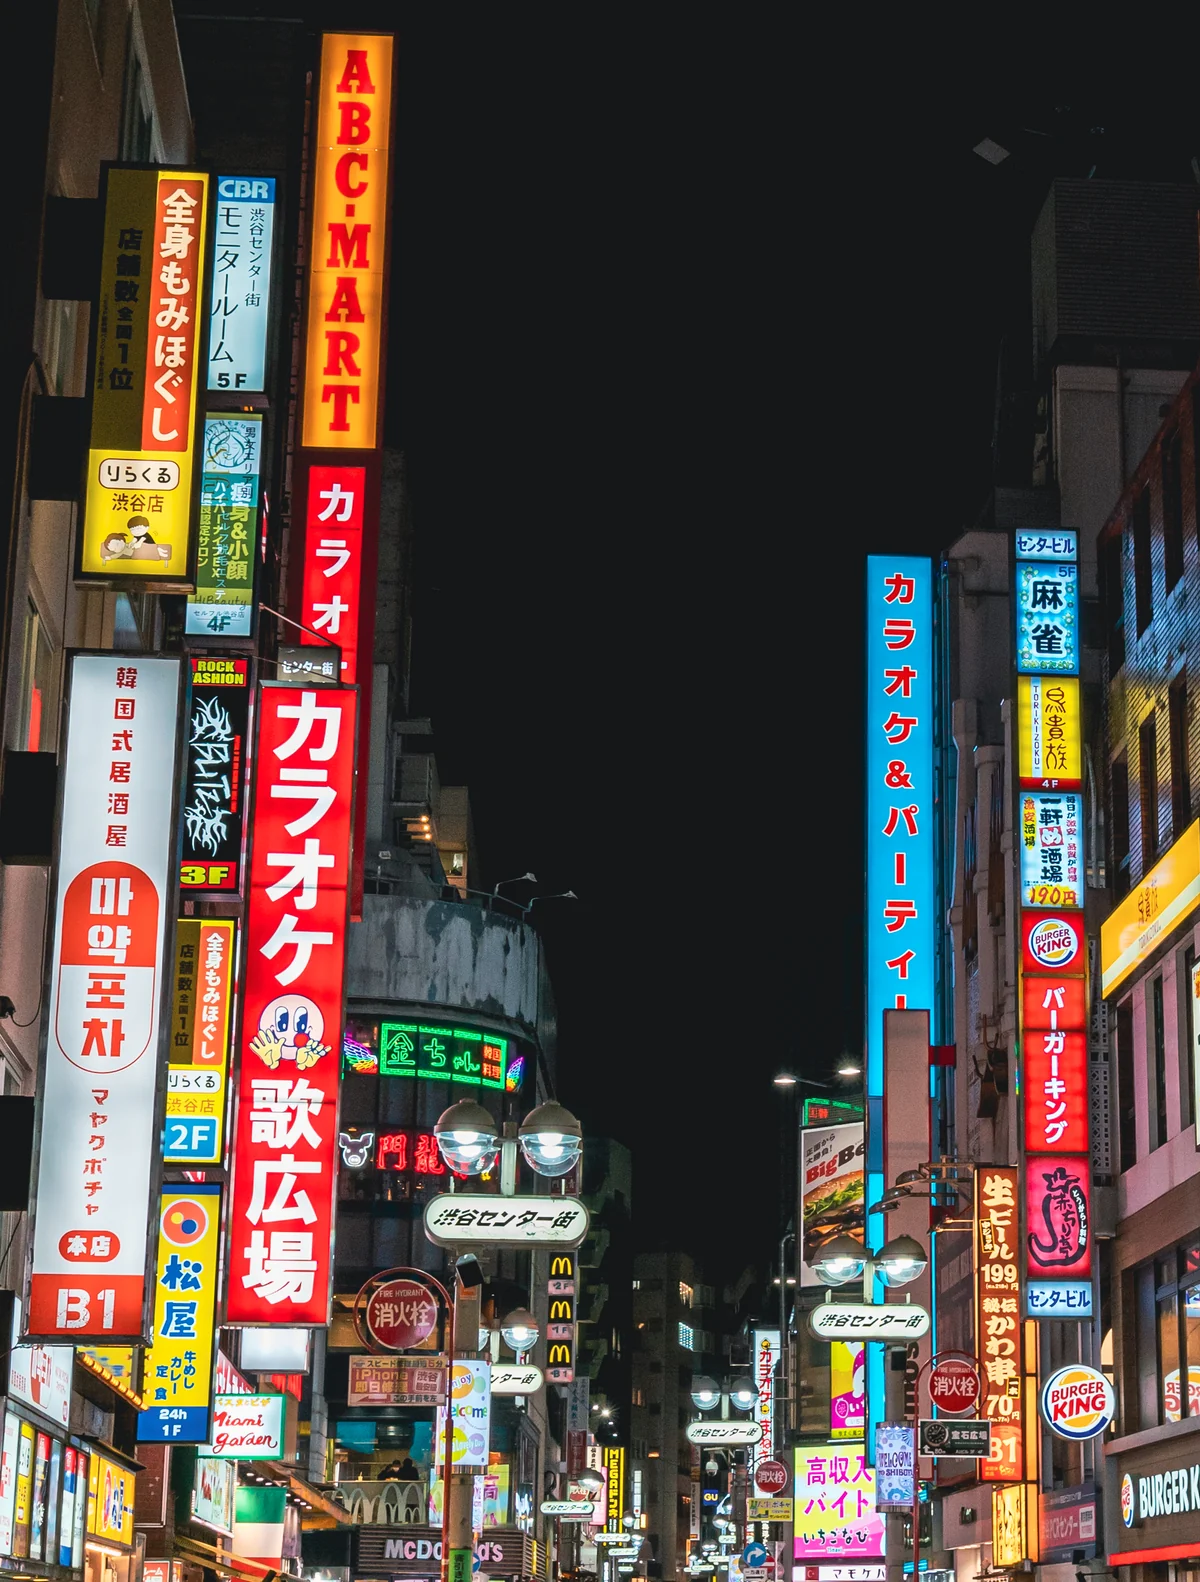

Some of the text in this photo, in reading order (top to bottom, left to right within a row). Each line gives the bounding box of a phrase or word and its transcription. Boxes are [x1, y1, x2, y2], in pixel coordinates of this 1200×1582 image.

[218, 180, 269, 199] CBR
[244, 208, 266, 307] 渋谷センター街
[209, 206, 242, 363] モニタールーム
[151, 188, 198, 442] 全身もみほぐし
[217, 373, 247, 388] 5F
[107, 465, 172, 483] りらくる
[111, 493, 165, 513] 渋谷店
[1017, 536, 1075, 554] センタービル
[312, 483, 355, 669] カラオ
[1058, 566, 1075, 577] 5F
[1031, 580, 1063, 655] 麻雀
[197, 660, 235, 672] ROCK
[281, 660, 334, 675] センター街
[191, 672, 244, 685] ASHION
[106, 666, 139, 848] 韓国式居酒屋
[1041, 780, 1059, 788] 4F
[259, 692, 343, 987] カラオケ
[180, 865, 230, 885] 3F
[1035, 928, 1070, 944] BURGER
[1037, 938, 1072, 957] KING
[80, 876, 134, 1058] 마약포차
[200, 932, 226, 1059] 全身もみほぐし
[387, 1031, 481, 1073] 金ちゃん
[1042, 986, 1068, 1144] バーガーキング
[168, 1075, 216, 1089] りらくる
[166, 1098, 216, 1113] 渋谷店
[169, 1125, 210, 1151] 2F
[83, 1088, 110, 1217] マヤクポチャ
[805, 1154, 839, 1185] Big
[242, 1078, 325, 1305] 歌広場
[433, 1208, 579, 1229] 渋谷センター街
[982, 1174, 1016, 1261] 生ビール
[67, 1235, 113, 1257] 本店
[981, 1264, 1018, 1283] 199
[160, 1254, 204, 1339] 松屋
[379, 1288, 425, 1298] FIRE HYDRANT
[1011, 1282, 1019, 1291] 円
[982, 1297, 1018, 1313] 秘伝
[1028, 1288, 1091, 1308] センタービル
[56, 1288, 116, 1330] B1
[373, 1300, 431, 1329] 消火栓
[818, 1314, 926, 1328] 渋谷センター街
[984, 1315, 1017, 1387] かわ串
[170, 1357, 182, 1394] カレー
[183, 1351, 197, 1389] 牛めし
[355, 1369, 409, 1381] iPhone
[416, 1371, 439, 1382] 渋谷
[759, 1351, 773, 1403] カラオケ
[154, 1365, 168, 1401] 定食
[933, 1376, 975, 1397] 消火栓
[1051, 1381, 1104, 1403] BURGER
[159, 1409, 188, 1420] 24h
[986, 1394, 1014, 1416] 70
[1051, 1393, 1106, 1423] KING
[161, 1424, 182, 1437] 1F
[691, 1427, 759, 1438] 渋谷センター街
[951, 1430, 988, 1440] 宝石広場
[879, 1451, 912, 1469] WELCOME
[986, 1436, 1017, 1463] B1
[757, 1470, 784, 1485] 消火栓
[806, 1455, 873, 1487] 高収入
[703, 1493, 719, 1502] GU
[804, 1489, 870, 1519] バイト
[1138, 1468, 1190, 1519] BURGER
[803, 1528, 870, 1546] いちごなび
[384, 1539, 504, 1563] McDod's
